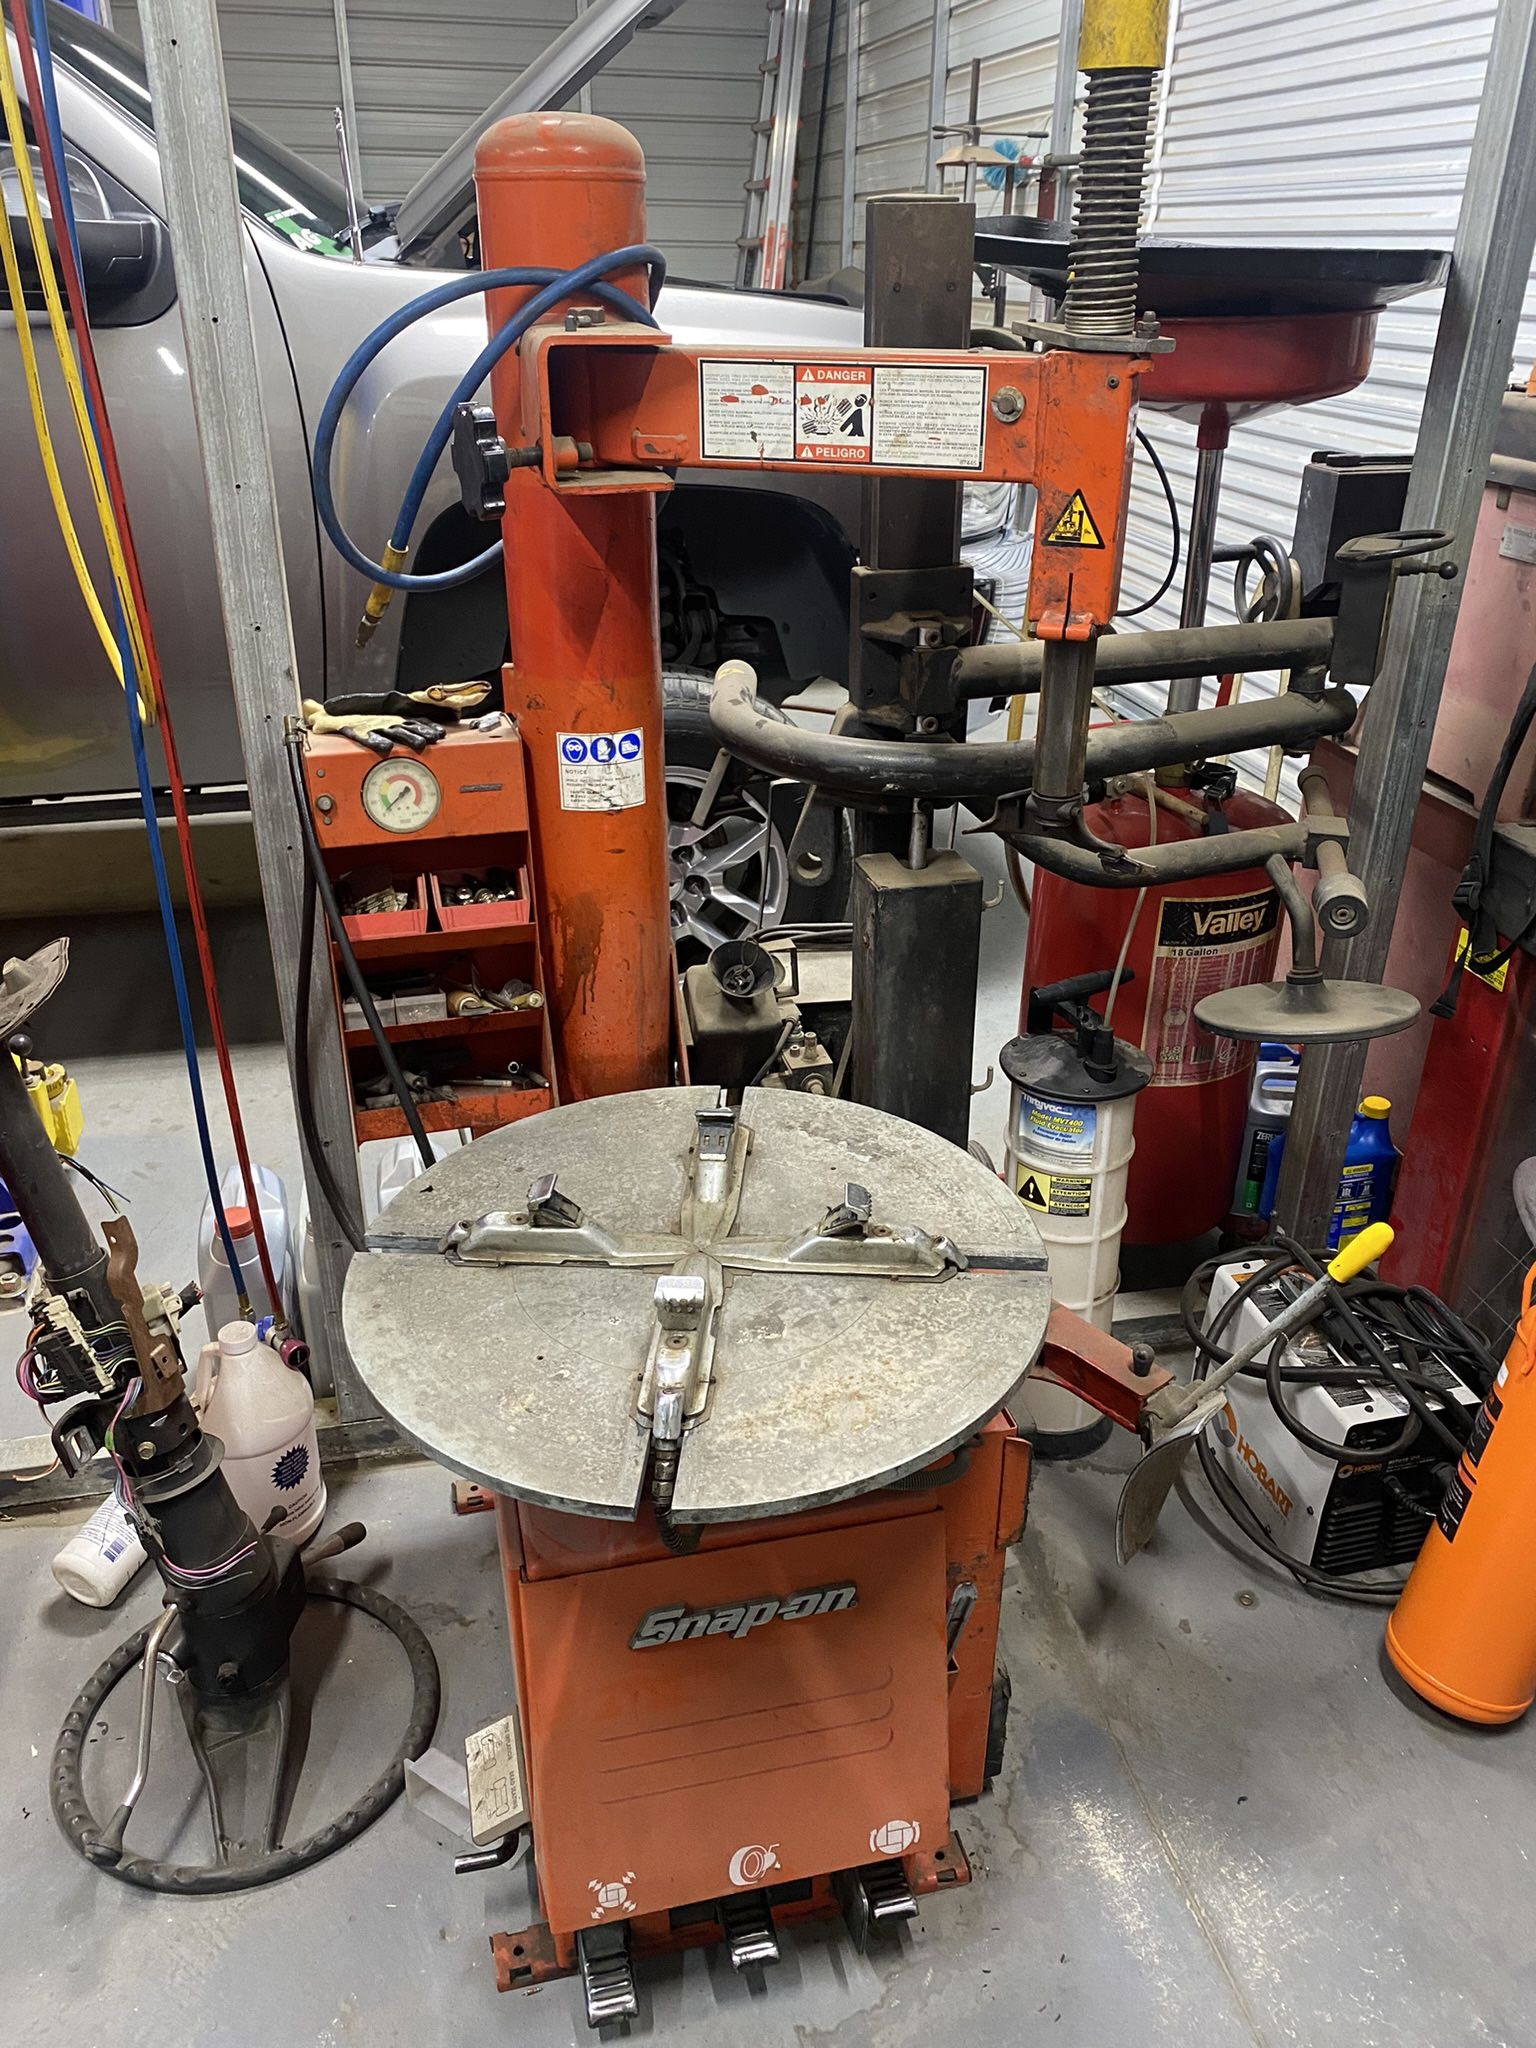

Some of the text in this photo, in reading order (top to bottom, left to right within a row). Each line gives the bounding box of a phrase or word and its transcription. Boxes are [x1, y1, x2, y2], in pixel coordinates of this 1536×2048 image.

[817, 370, 866, 381] DANGER
[815, 447, 866, 459] PELIGRO
[1193, 900, 1269, 936] Valley
[1172, 948, 1219, 957] 18 Gallon
[1031, 1109, 1084, 1127] Model MV7400
[1047, 1123, 1083, 1134] Evacuator
[1237, 1434, 1294, 1517] HOBART
[631, 1584, 857, 1650] Snap-on
